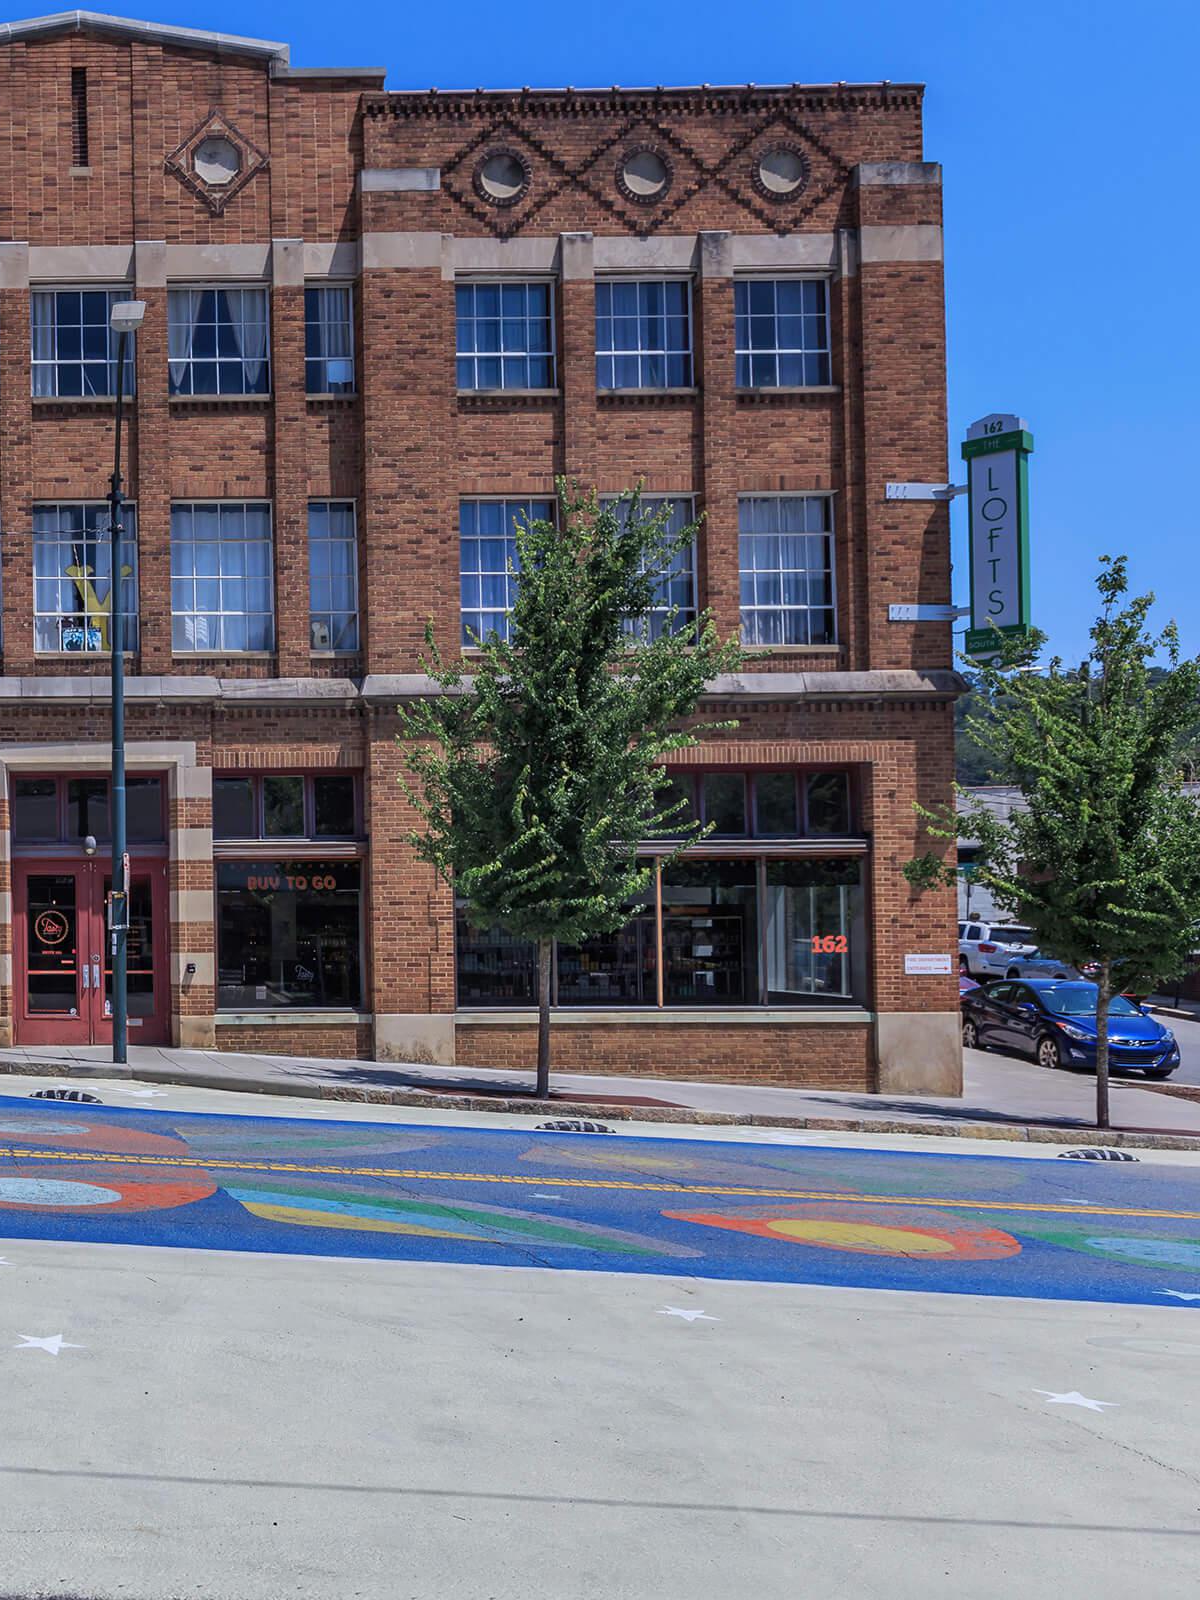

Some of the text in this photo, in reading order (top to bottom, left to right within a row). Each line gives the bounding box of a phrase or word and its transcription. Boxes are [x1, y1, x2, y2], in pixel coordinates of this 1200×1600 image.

[984, 420, 1003, 435] 162
[981, 467, 1008, 615] LOFTS
[247, 874, 337, 891] BUY TO GO
[811, 935, 849, 953] 162
